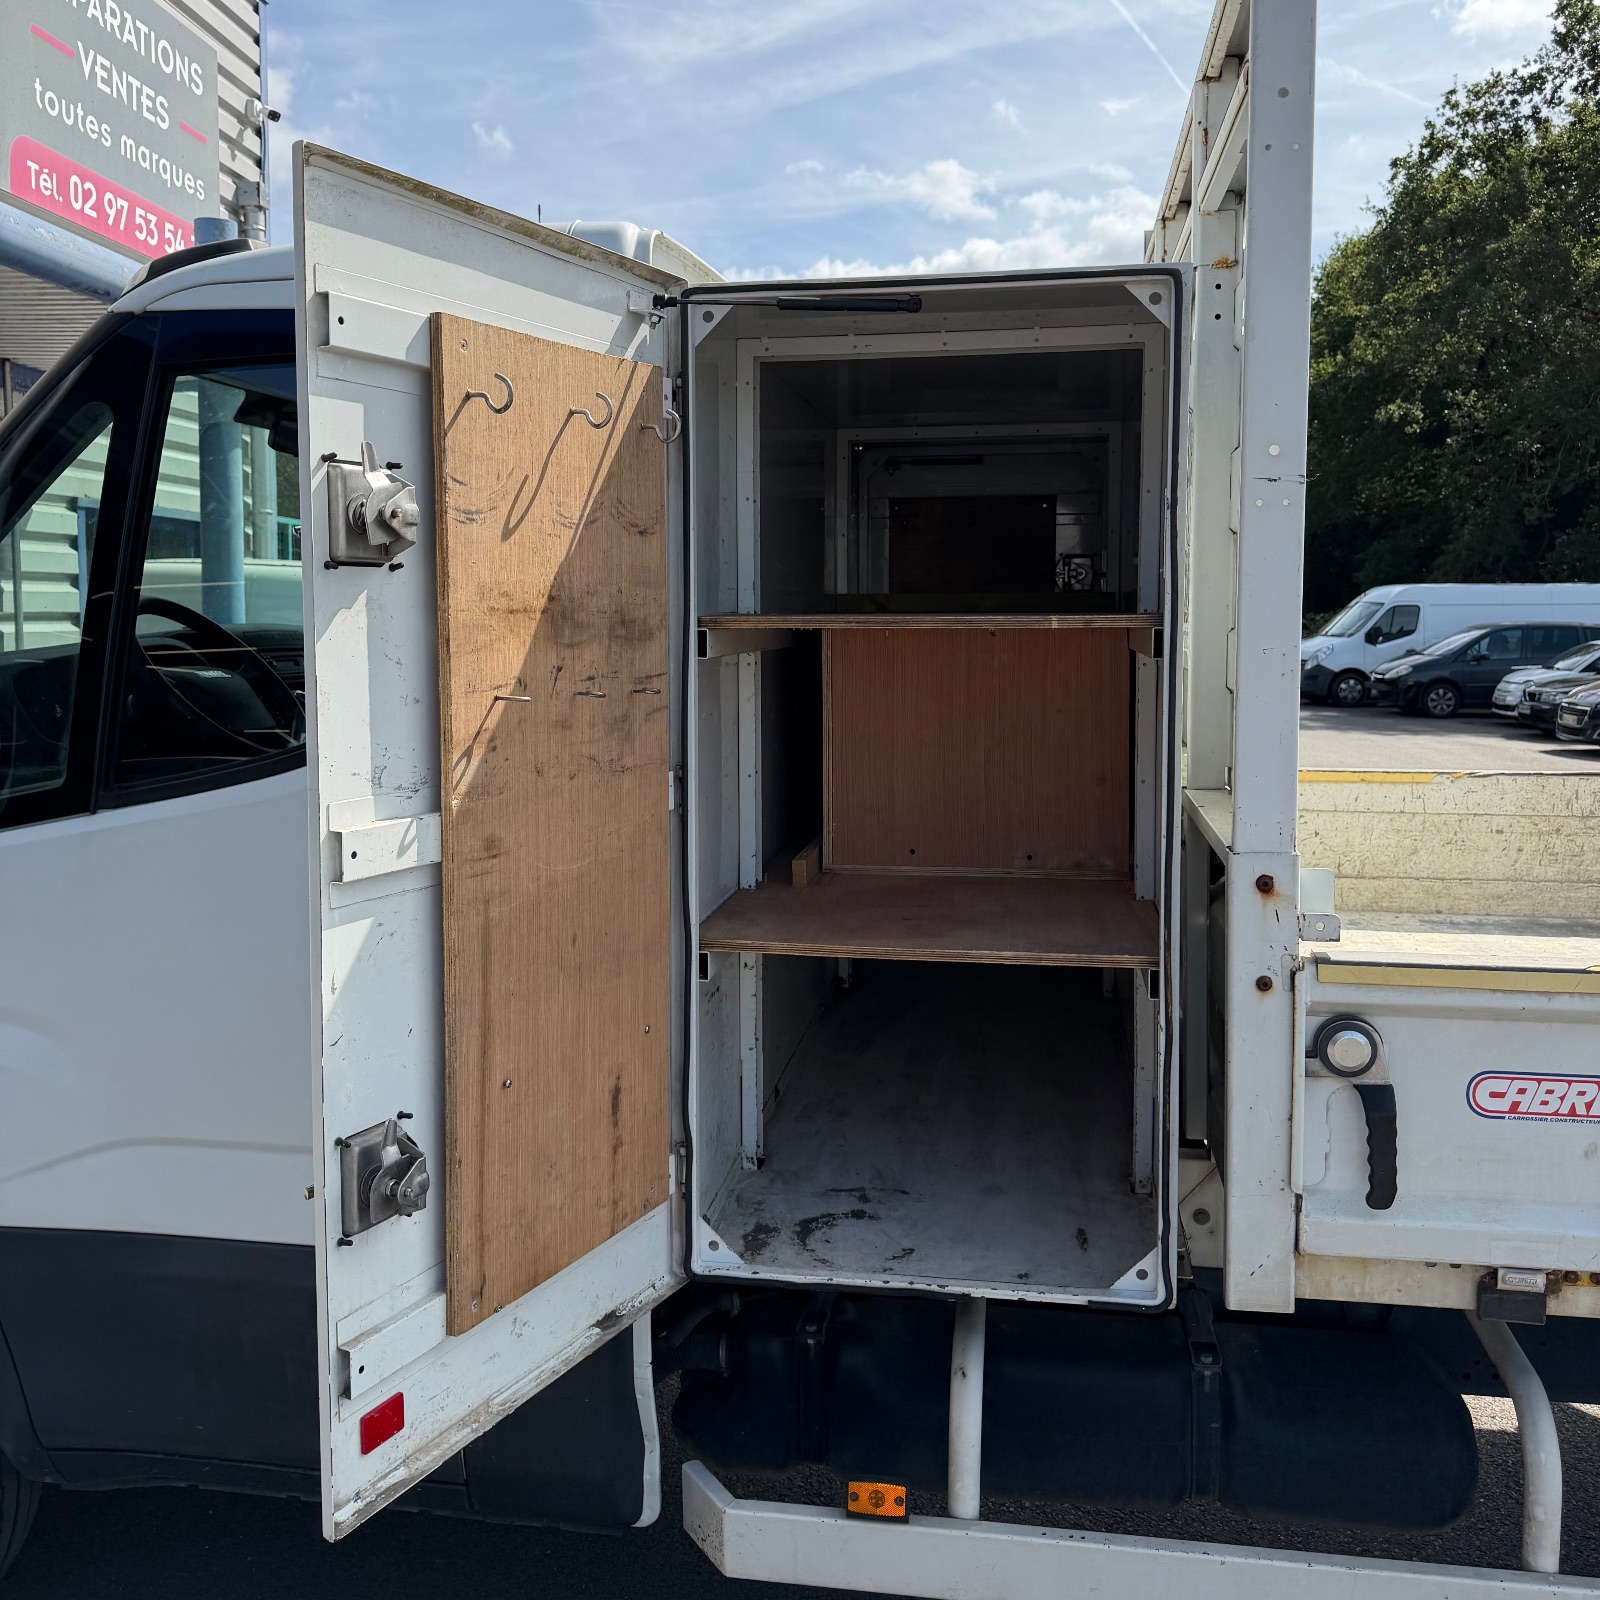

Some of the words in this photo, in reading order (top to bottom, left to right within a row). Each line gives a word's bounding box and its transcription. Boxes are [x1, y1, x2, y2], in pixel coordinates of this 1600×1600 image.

[65, 0, 204, 95] ARATIONS
[77, 41, 170, 130] VENTES
[34, 77, 112, 148] toutes
[120, 134, 205, 201] marques
[26, 160, 64, 203] Tél.
[69, 174, 97, 219] 02
[103, 192, 129, 231] 97
[135, 206, 158, 246] 53
[164, 222, 186, 254] 54
[1475, 1079, 1600, 1115] CABR
[1507, 1115, 1549, 1123] CARROSSIER
